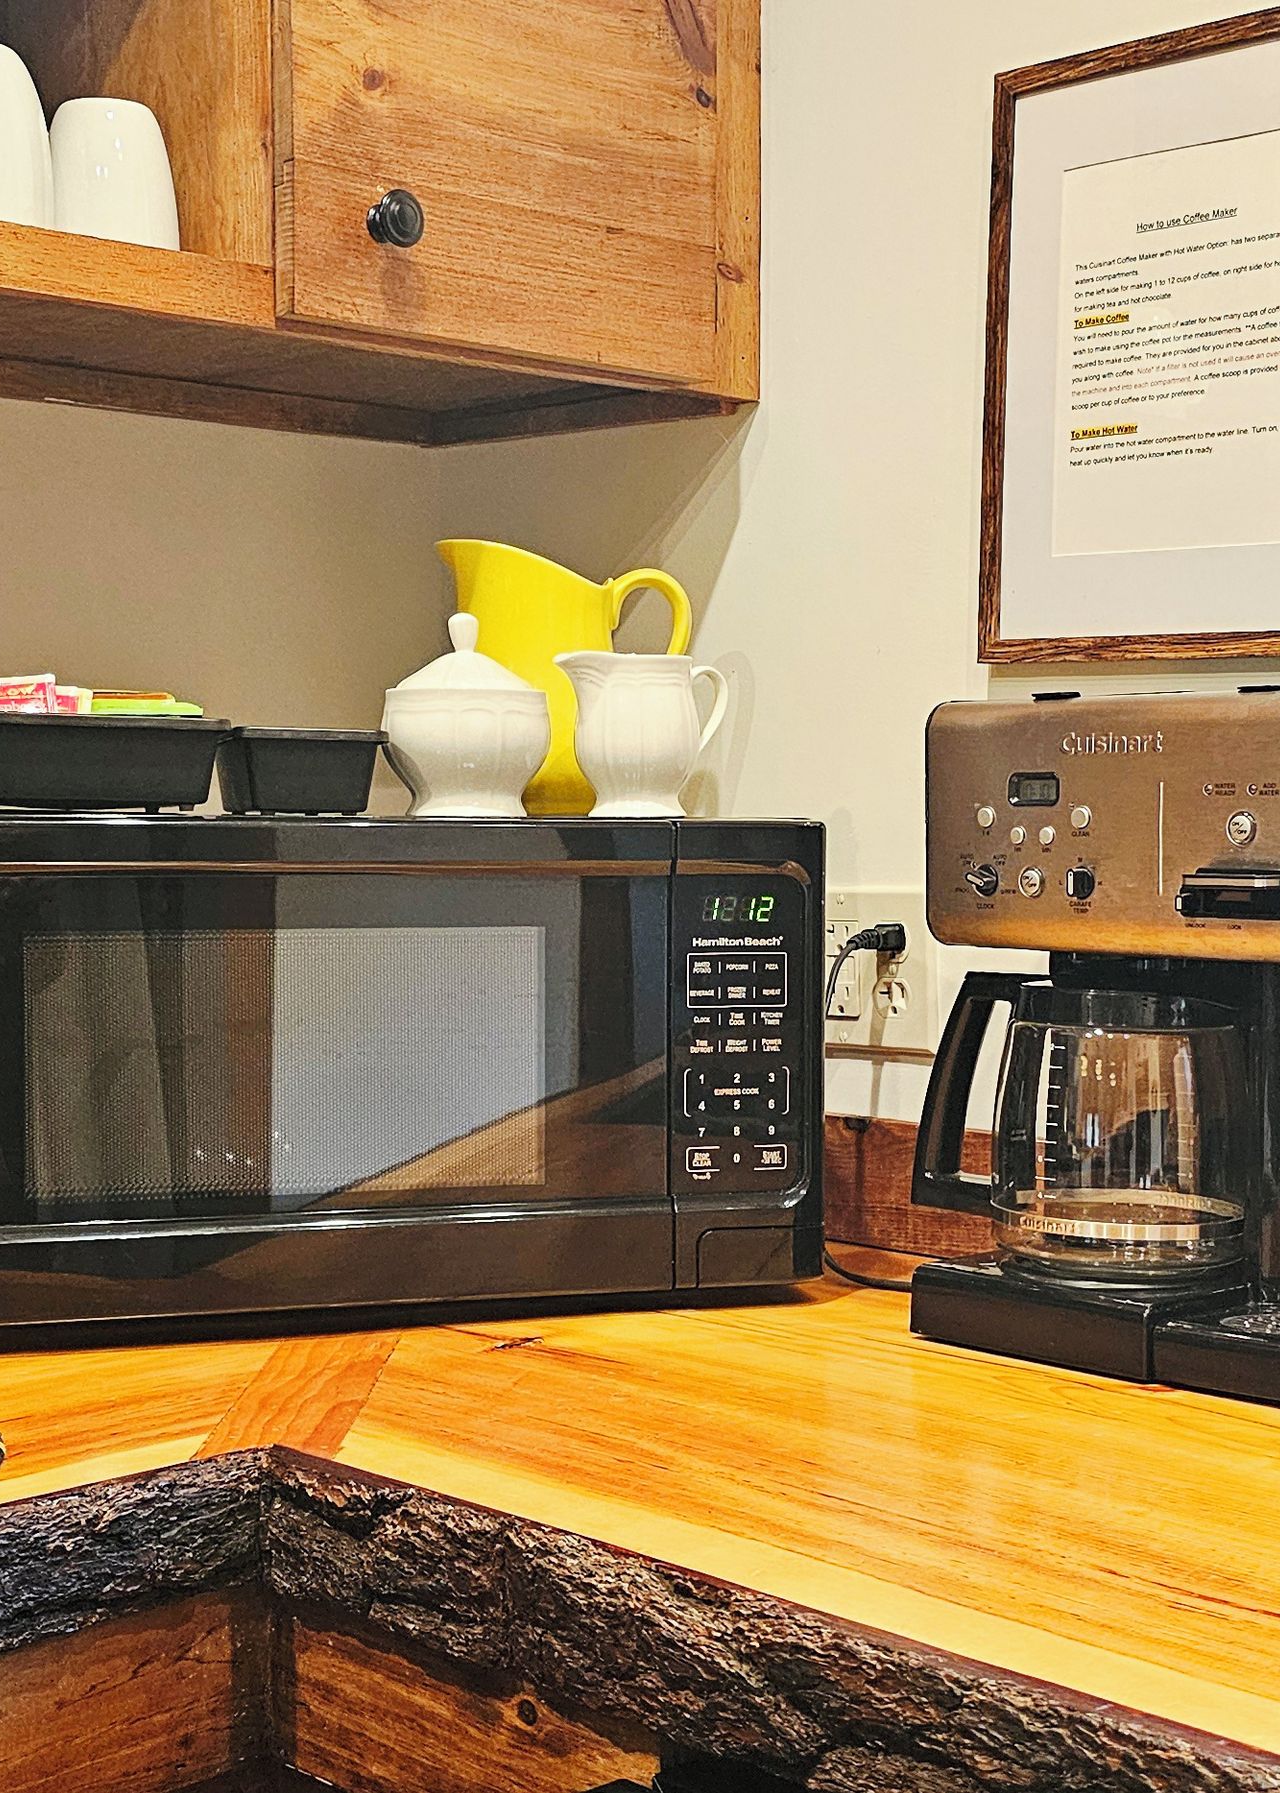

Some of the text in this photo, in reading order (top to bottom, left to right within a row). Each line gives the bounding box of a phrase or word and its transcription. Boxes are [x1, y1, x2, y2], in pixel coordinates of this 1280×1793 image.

[1135, 207, 1237, 233] How to use Coffee Maker
[1073, 313, 1129, 329] To Make Coffee
[1070, 424, 1138, 441] To Make Hot Water
[1060, 730, 1164, 754] Cuisinart
[692, 937, 744, 947] Hamilton
[698, 1072, 775, 1084] 1 2 3
[741, 1087, 759, 1095] COOK
[698, 1099, 775, 1111] 4 5 6
[698, 1125, 775, 1137] 7 8 9
[733, 1153, 740, 1163] 0
